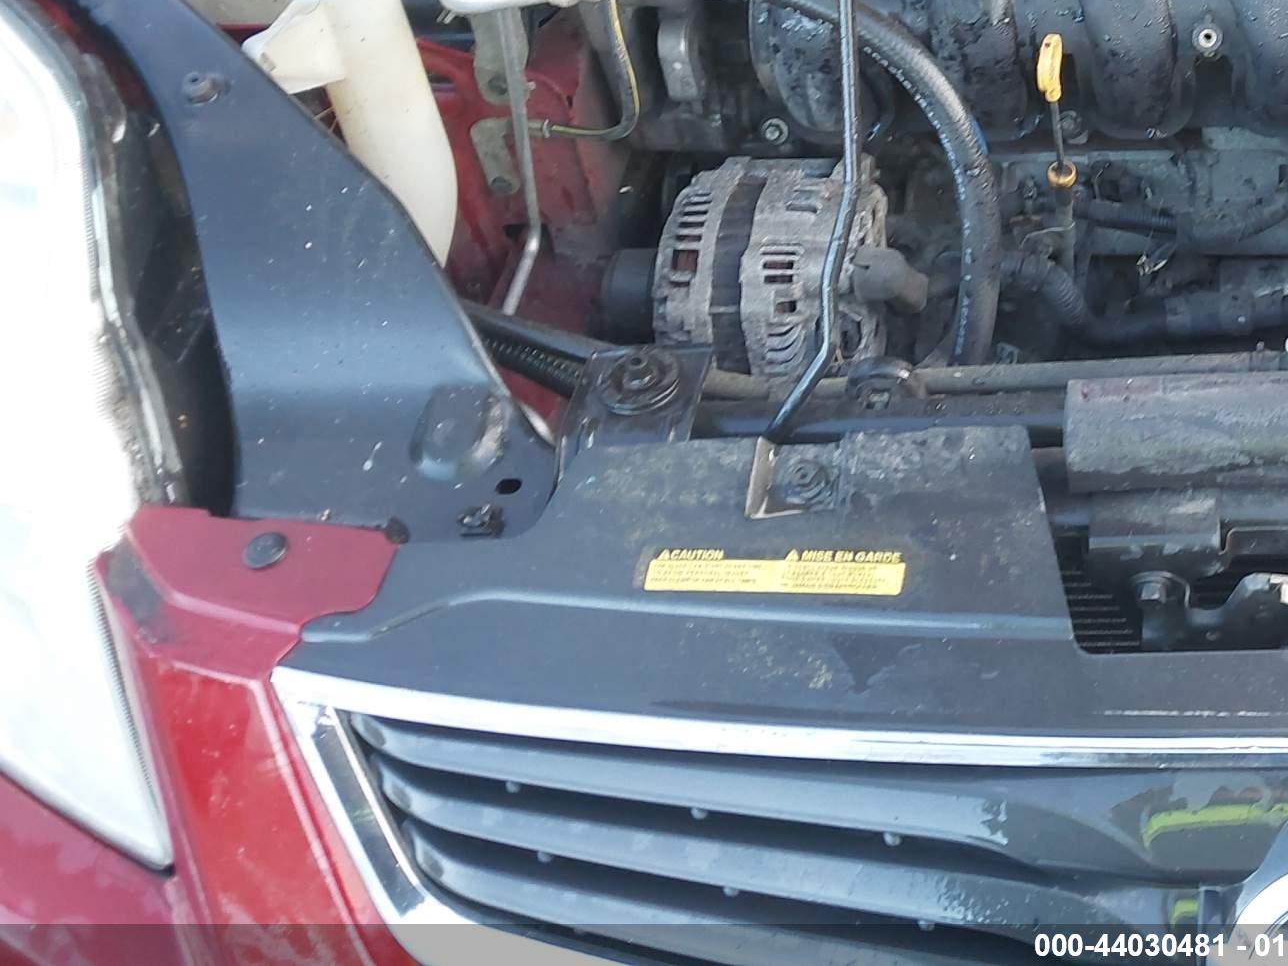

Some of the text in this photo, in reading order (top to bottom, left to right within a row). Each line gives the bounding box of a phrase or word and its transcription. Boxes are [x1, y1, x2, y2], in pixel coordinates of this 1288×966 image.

[670, 549, 724, 561] CAUTION
[800, 549, 902, 564] MISE EN GARDE
